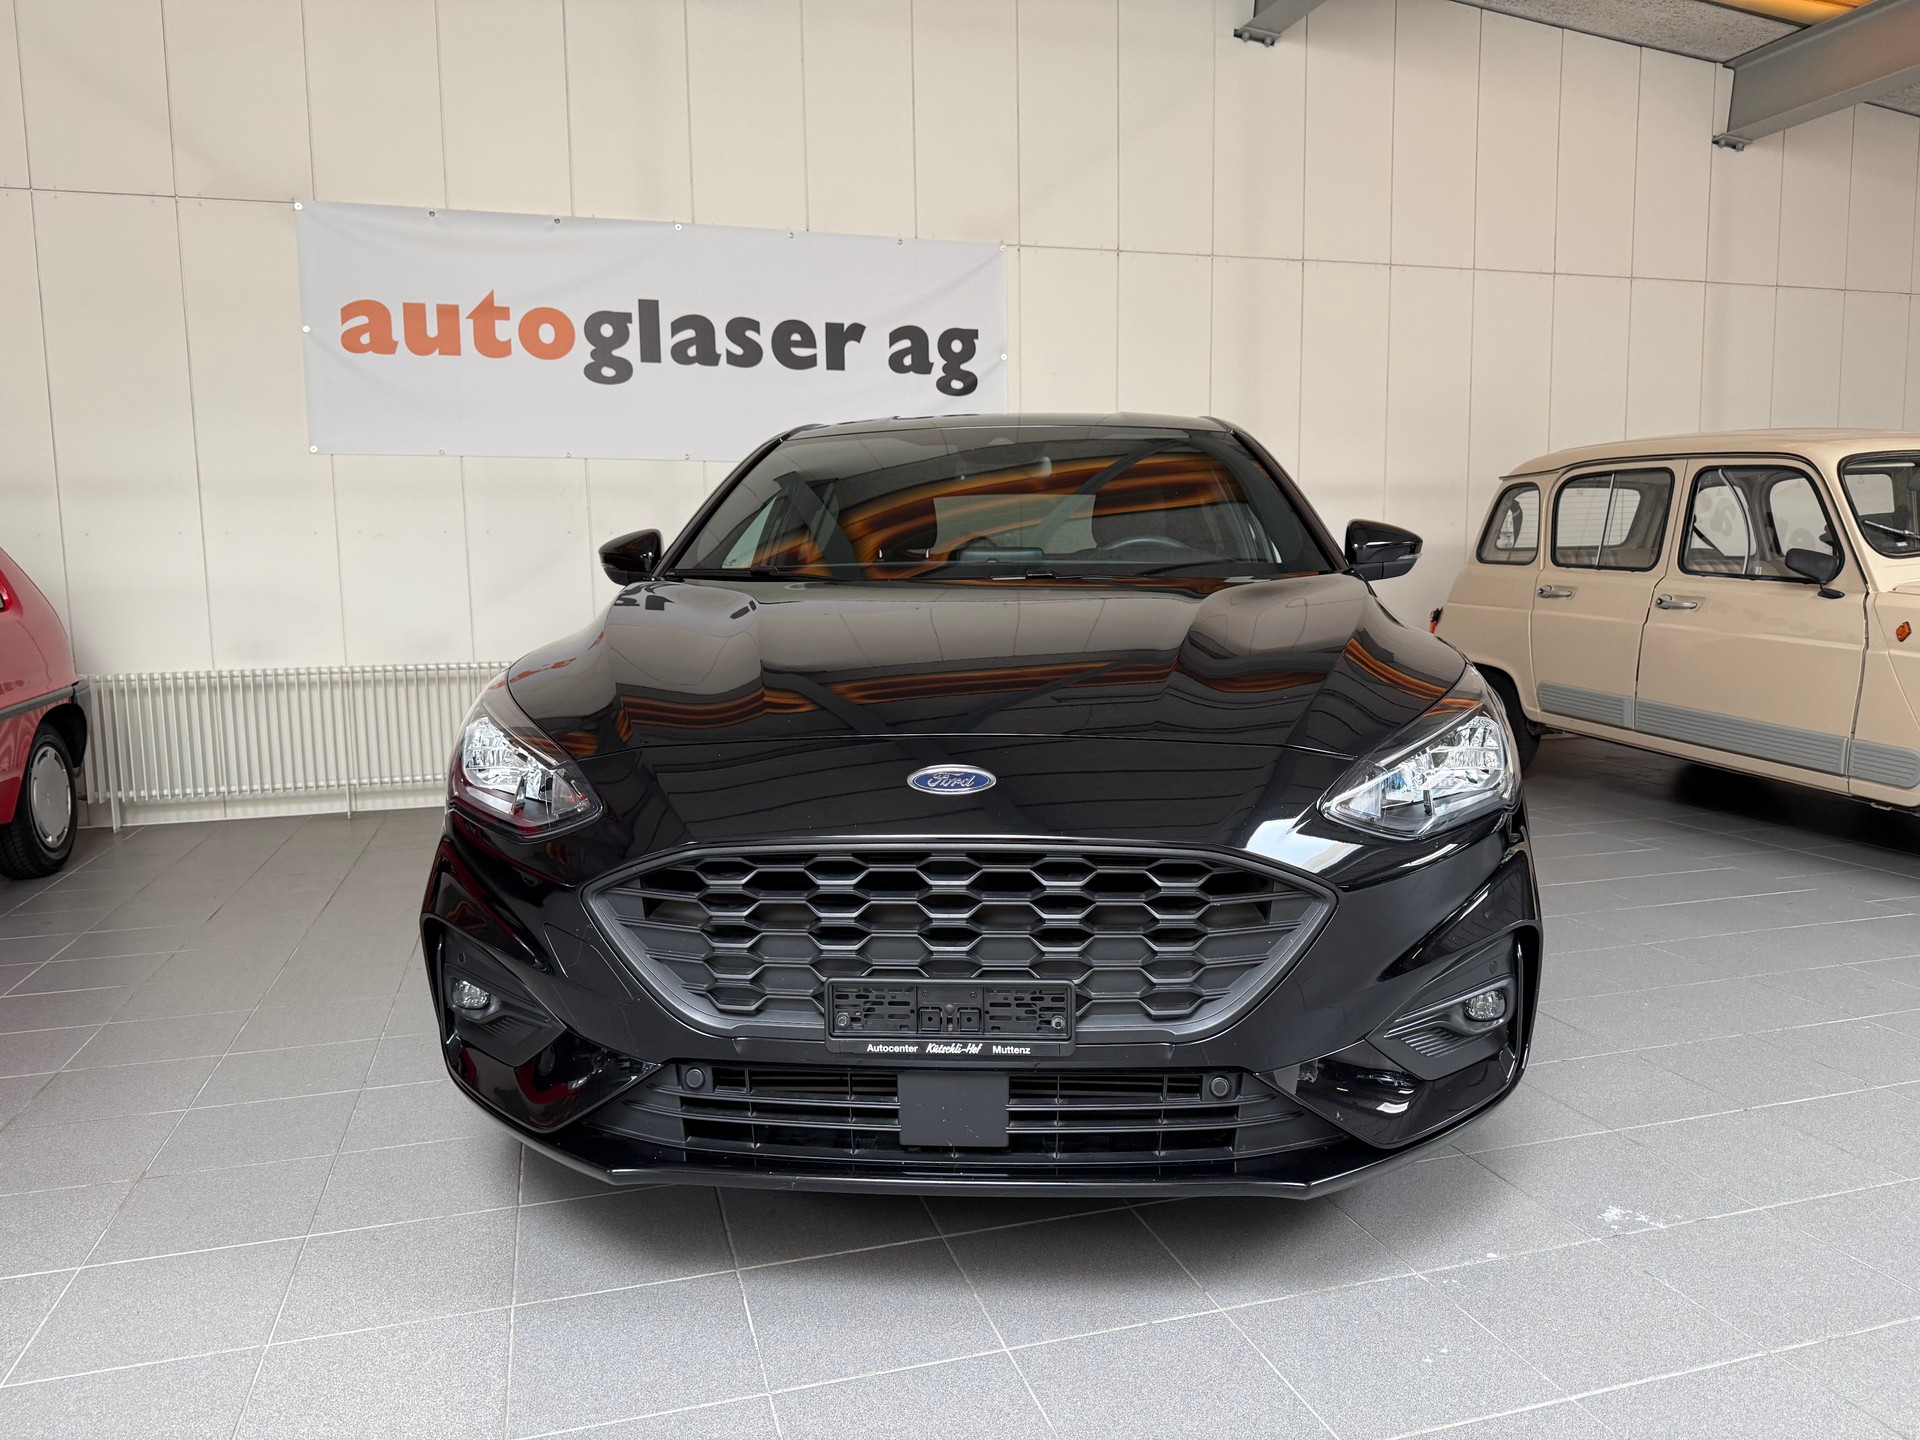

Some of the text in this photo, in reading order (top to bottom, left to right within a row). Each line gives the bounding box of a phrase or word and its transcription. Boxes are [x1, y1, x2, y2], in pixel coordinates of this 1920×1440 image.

[340, 290, 979, 397] autoglaser ag
[927, 773, 975, 788] Ford
[866, 1043, 919, 1053] Autocenter
[992, 1045, 1031, 1055] Muttenz
